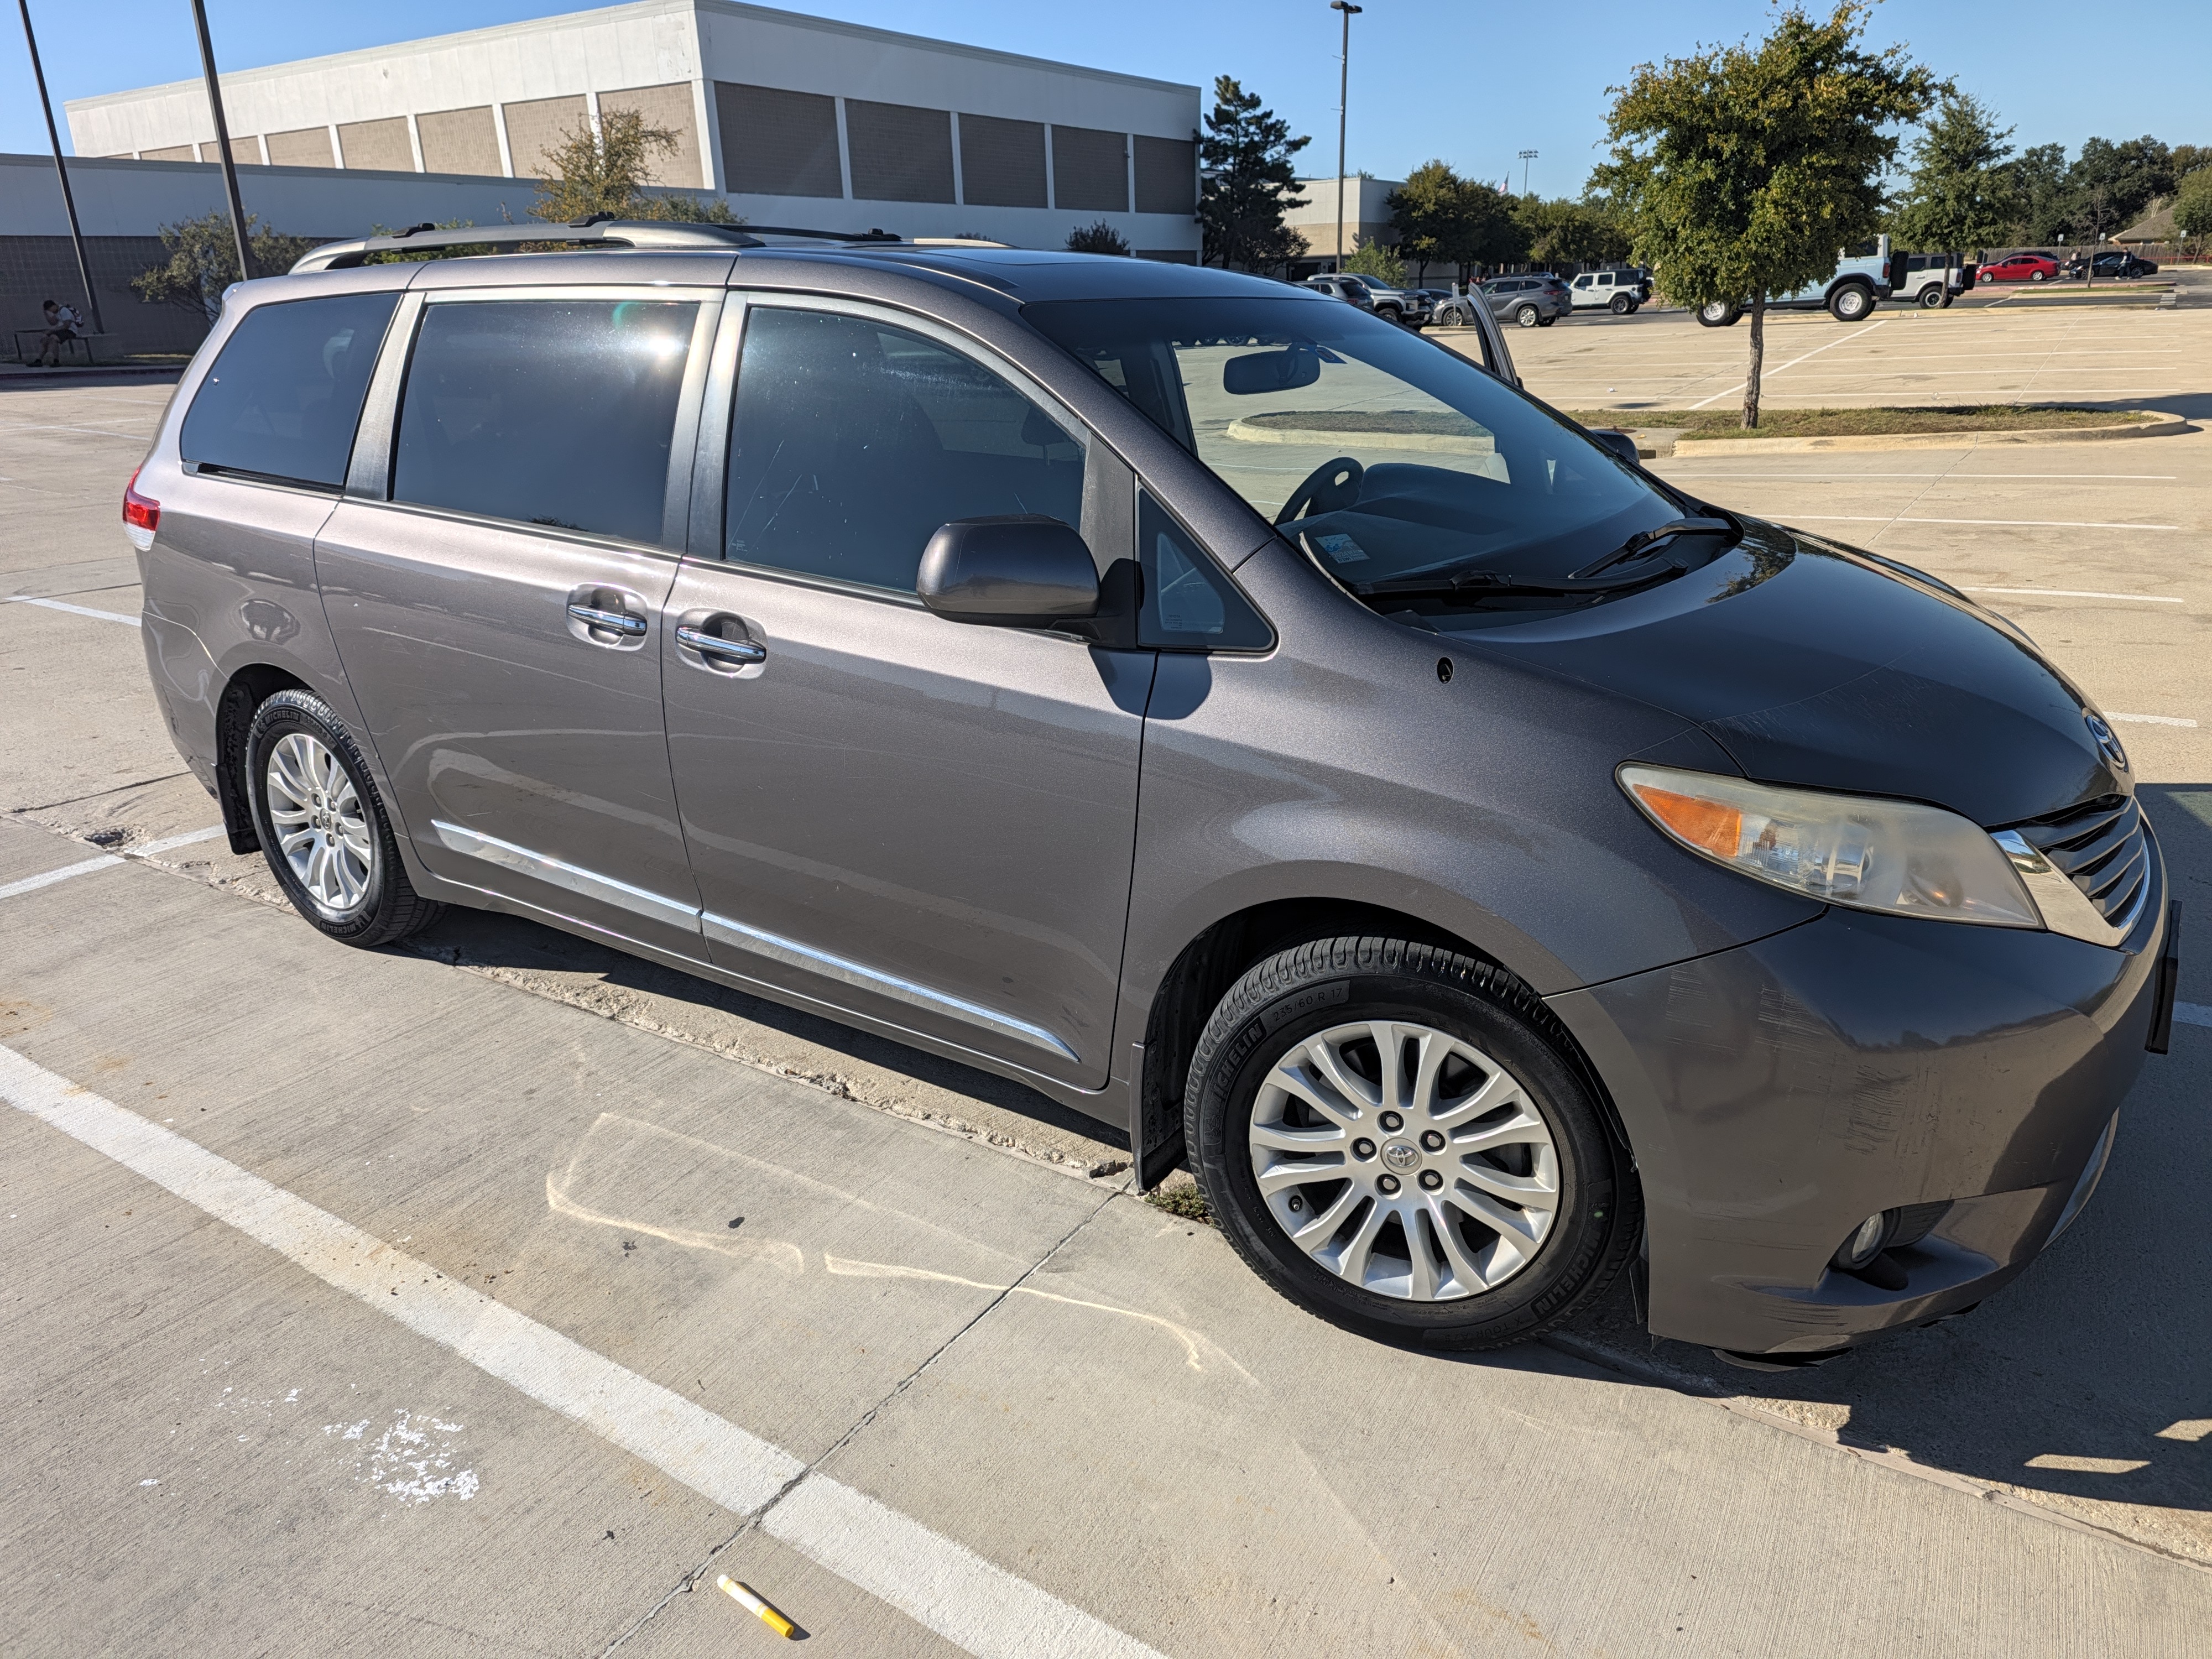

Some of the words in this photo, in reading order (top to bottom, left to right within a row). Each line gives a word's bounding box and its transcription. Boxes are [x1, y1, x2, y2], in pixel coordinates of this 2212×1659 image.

[264, 709, 299, 724] MICHELIN
[321, 922, 356, 934] MICHELIN
[1274, 996, 1313, 1022] 235/60
[1318, 992, 1326, 1002] R
[1331, 988, 1343, 998] 17
[1209, 1023, 1264, 1111] MICHELIN
[1535, 1229, 1602, 1315] MICHELIN
[1444, 1333, 1470, 1343] A/S
[1475, 1323, 1510, 1338] TOUR
